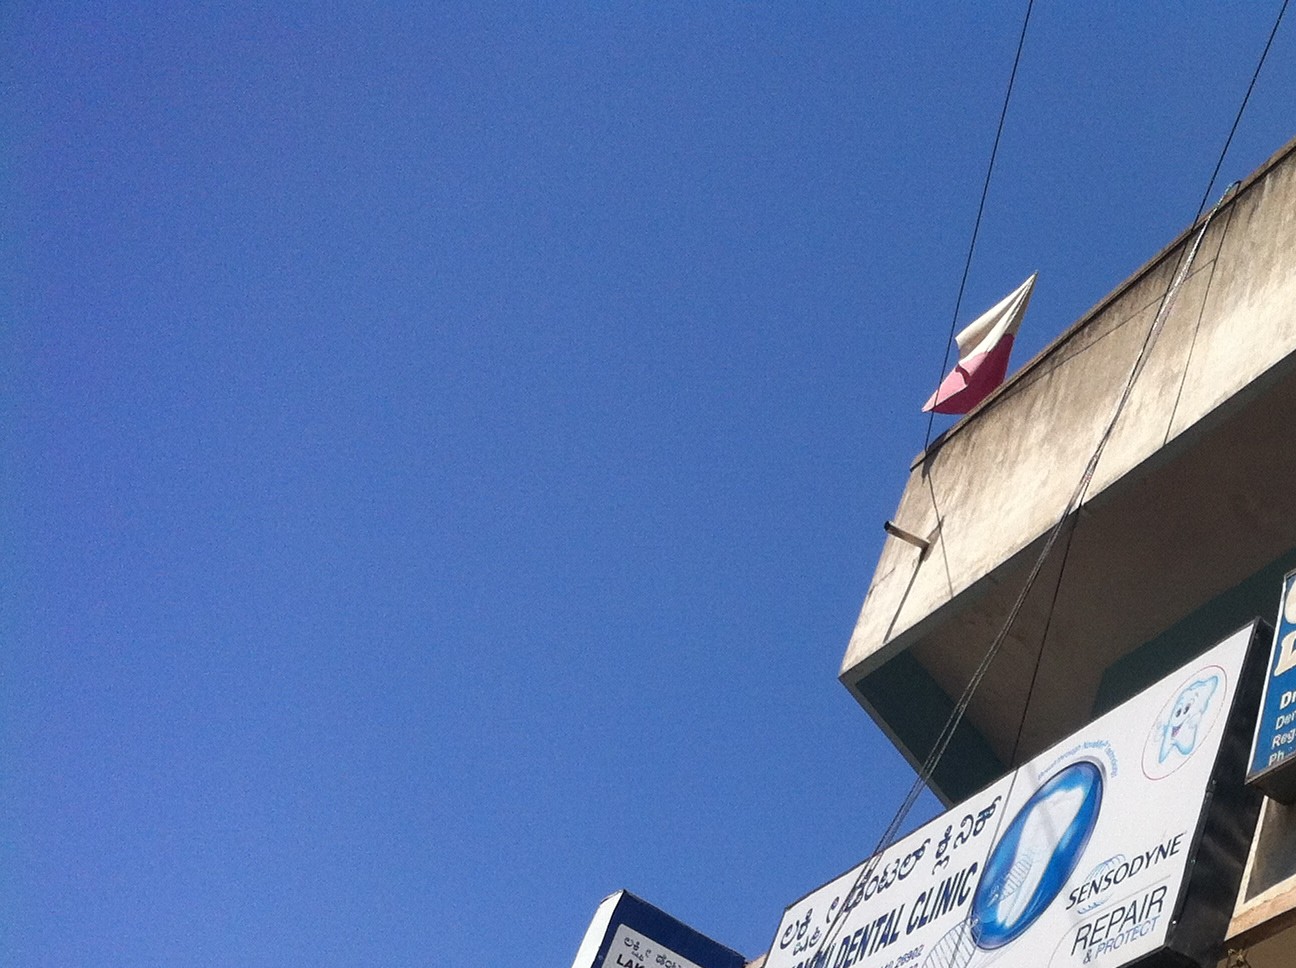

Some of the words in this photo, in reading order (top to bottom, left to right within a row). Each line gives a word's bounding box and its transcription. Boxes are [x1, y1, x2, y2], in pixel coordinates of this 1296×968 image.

[906, 862, 979, 935] CLINIC
[1066, 832, 1184, 910] SENSODYNE
[1071, 885, 1168, 956] REPAIR
[1095, 915, 1161, 957] PROTECT
